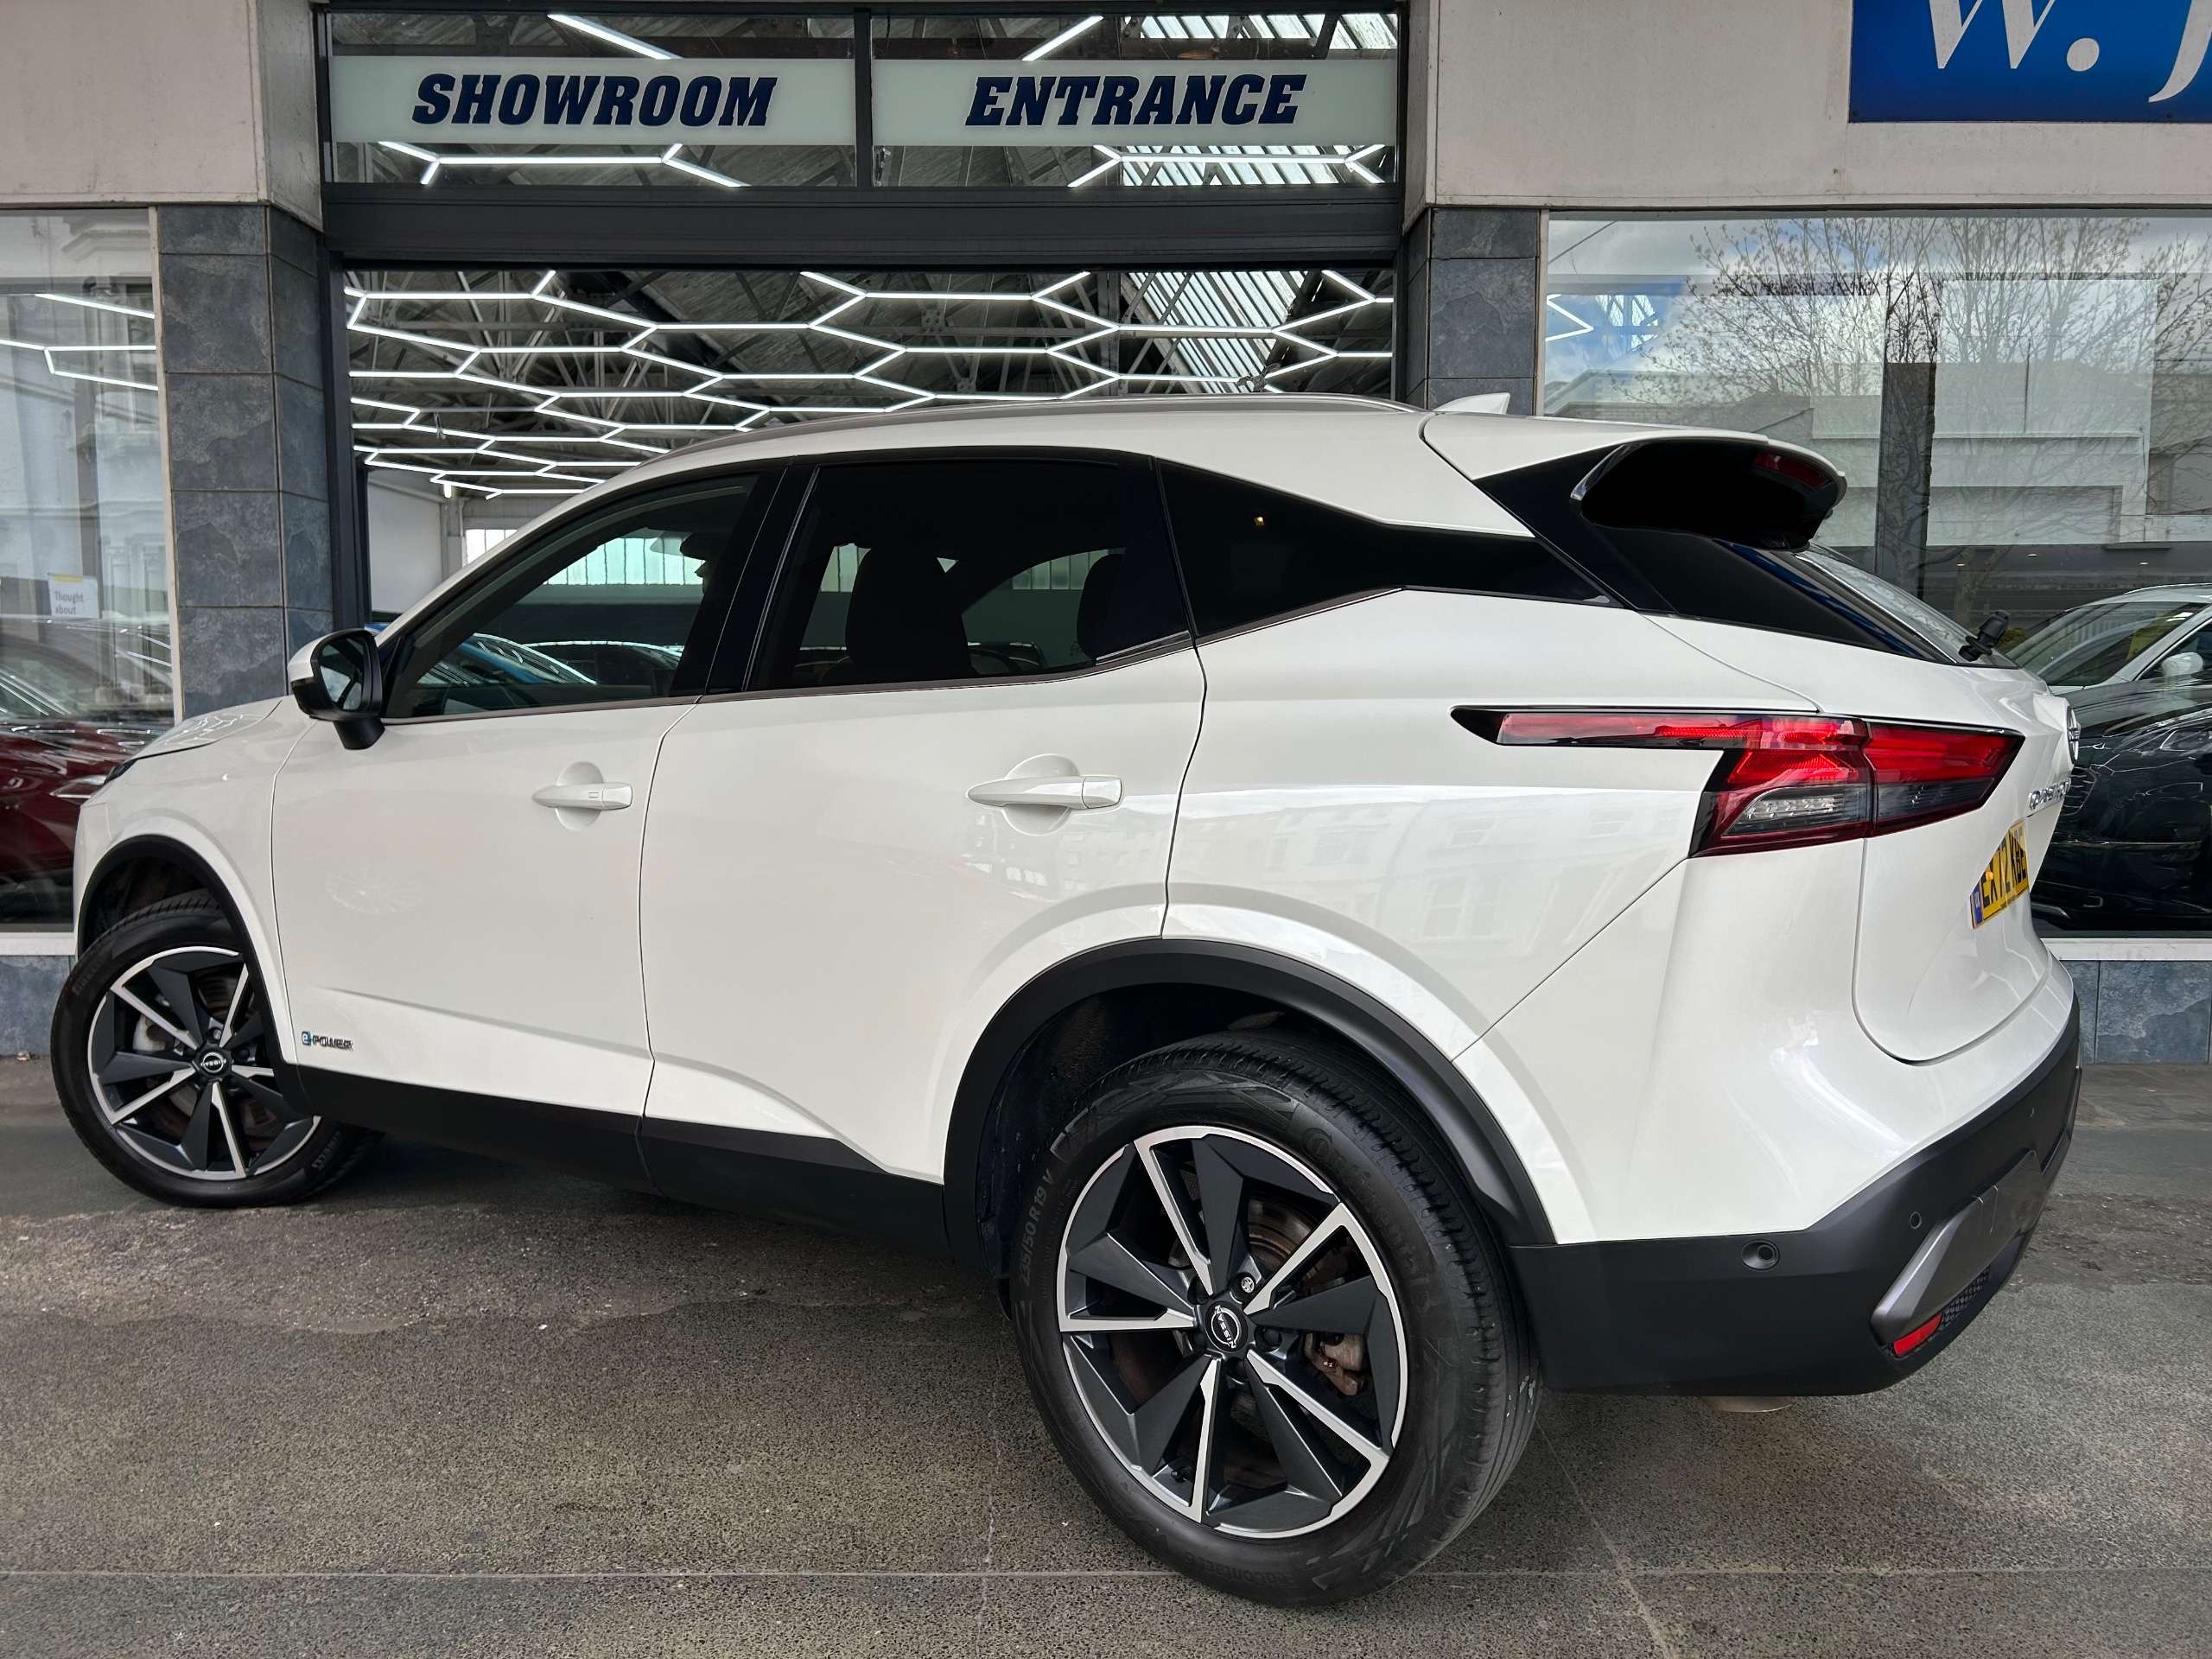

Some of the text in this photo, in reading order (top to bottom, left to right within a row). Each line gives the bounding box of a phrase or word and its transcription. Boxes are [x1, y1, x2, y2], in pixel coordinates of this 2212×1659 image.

[411, 73, 1306, 127] SHOWROOM ENTRANCE
[54, 591, 84, 605] Thought
[55, 605, 76, 615] about
[1215, 1305, 1236, 1348] NISSAN
